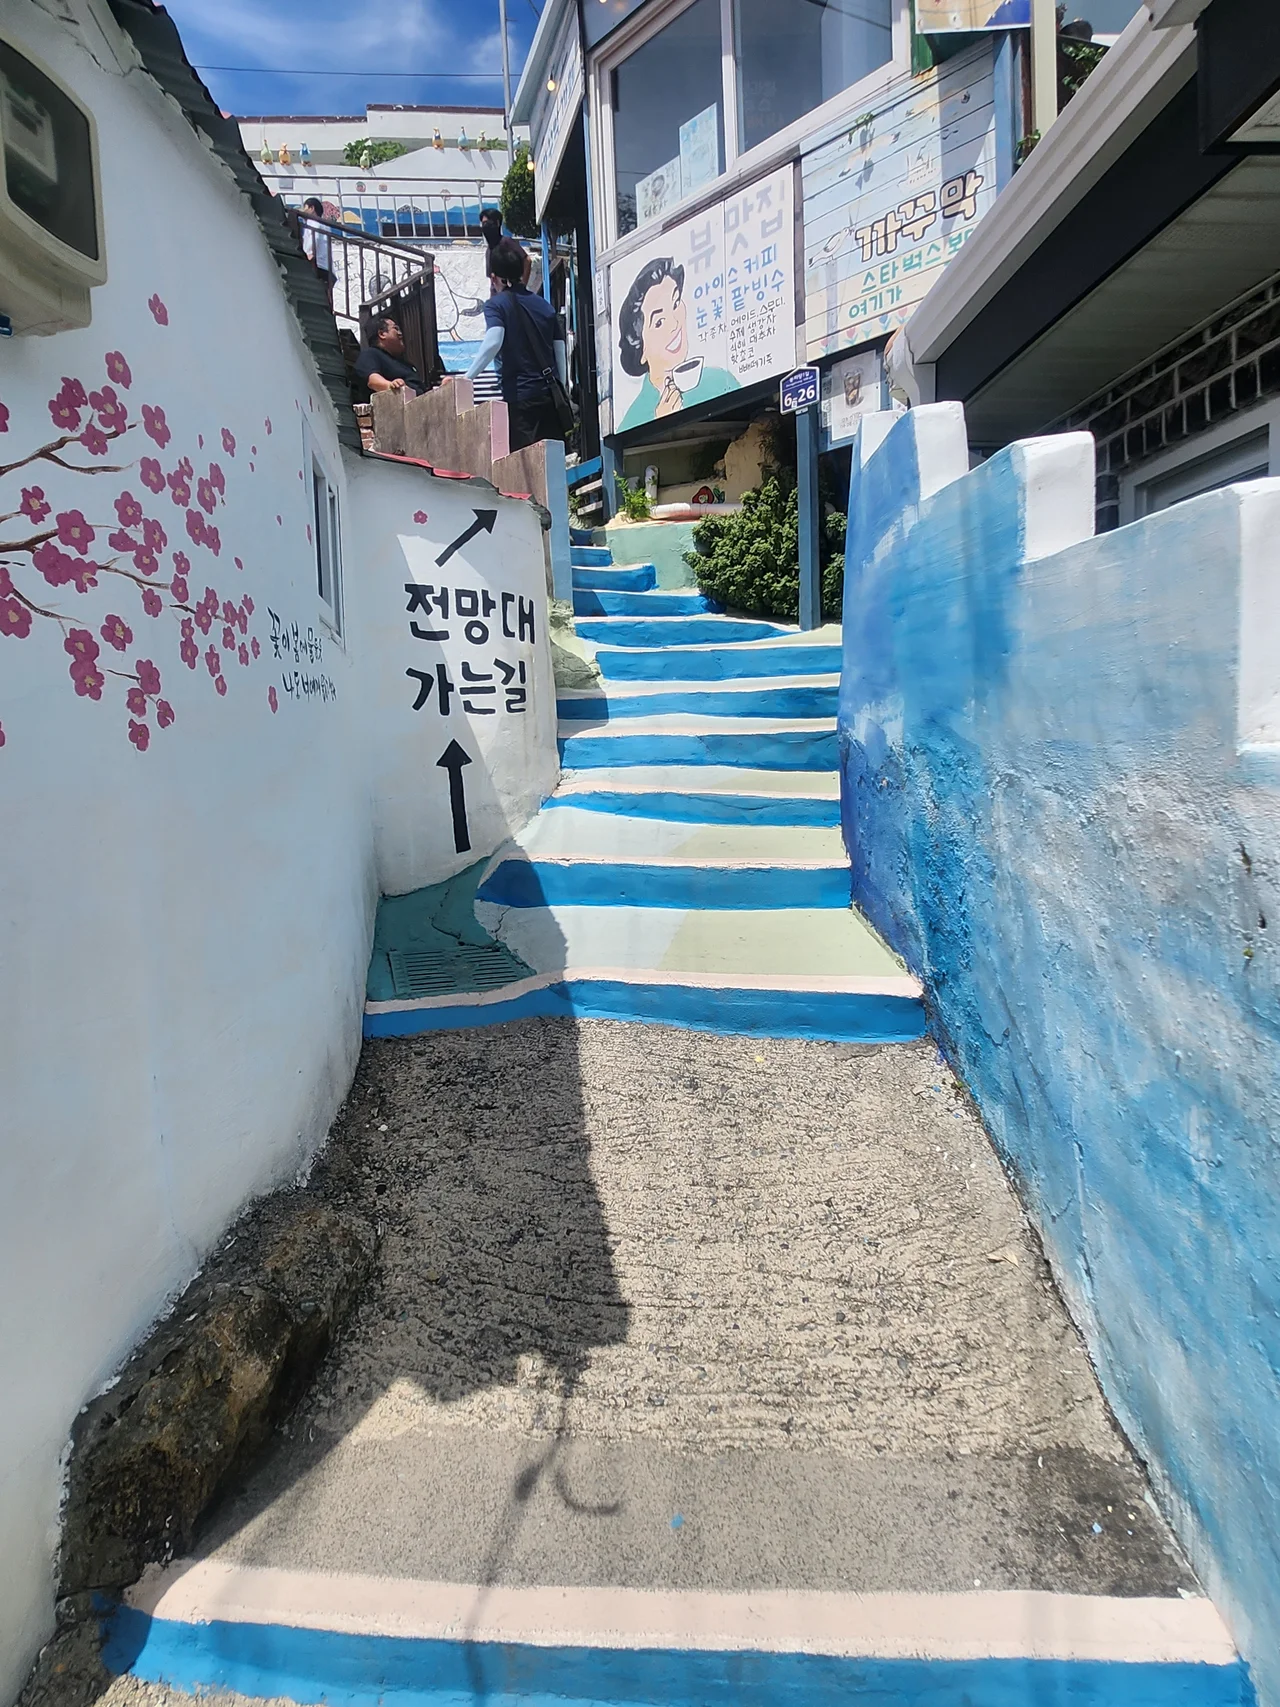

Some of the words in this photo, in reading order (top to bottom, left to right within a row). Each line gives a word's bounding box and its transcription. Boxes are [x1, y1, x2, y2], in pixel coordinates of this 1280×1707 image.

[855, 170, 984, 263] 까꾸막
[860, 243, 942, 294] 스타벅스
[948, 227, 975, 256] 보
[730, 268, 785, 312] 팥빙수
[848, 285, 903, 319] 여기가
[729, 326, 746, 342] 수제
[747, 313, 777, 334] 생강차
[749, 326, 777, 344] 대추차
[730, 346, 755, 365] 핫초코
[784, 384, 815, 407] 6-26
[266, 605, 290, 661] 꽃이
[404, 583, 536, 646] 전망대
[404, 656, 527, 717] 가는길
